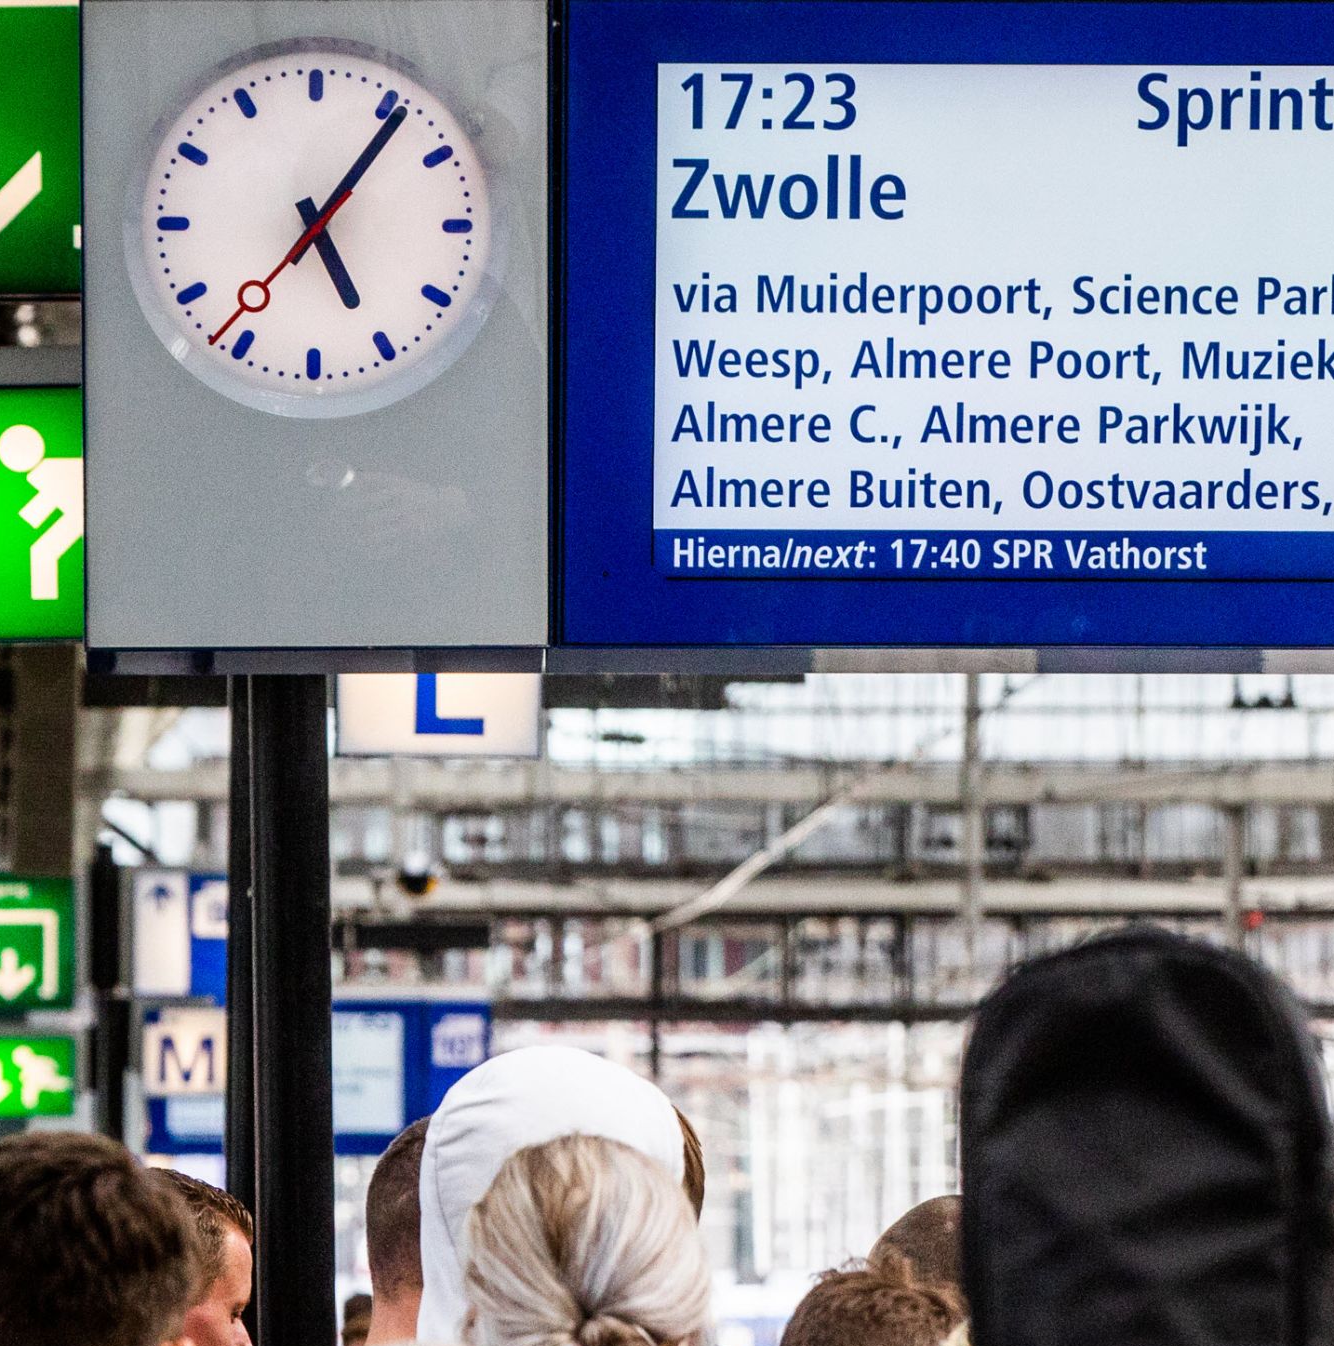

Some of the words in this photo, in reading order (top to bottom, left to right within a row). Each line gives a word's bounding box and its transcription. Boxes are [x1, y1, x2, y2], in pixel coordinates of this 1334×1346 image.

[681, 73, 857, 131] 17:23
[671, 155, 907, 221] Zwolle
[673, 273, 737, 314] via
[757, 272, 1052, 322] Muiderpoort,
[1072, 274, 1238, 316] Science
[673, 340, 832, 389] Weesp,
[850, 338, 1011, 380] Almere
[1030, 341, 1161, 385] Poort,
[671, 401, 832, 444] Almere
[849, 406, 901, 449] C.,
[920, 402, 1080, 445] Almere
[1098, 403, 1302, 455] Parkwijk,
[671, 467, 831, 509] Almere
[850, 468, 1003, 514] Buiten,
[1022, 468, 1332, 516] Oostvaarders,
[673, 538, 876, 569] Hierna/next:
[891, 540, 981, 568] 17:40
[992, 540, 1053, 568] SPR
[1065, 539, 1207, 570] Vathorst
[159, 1035, 214, 1083] M
